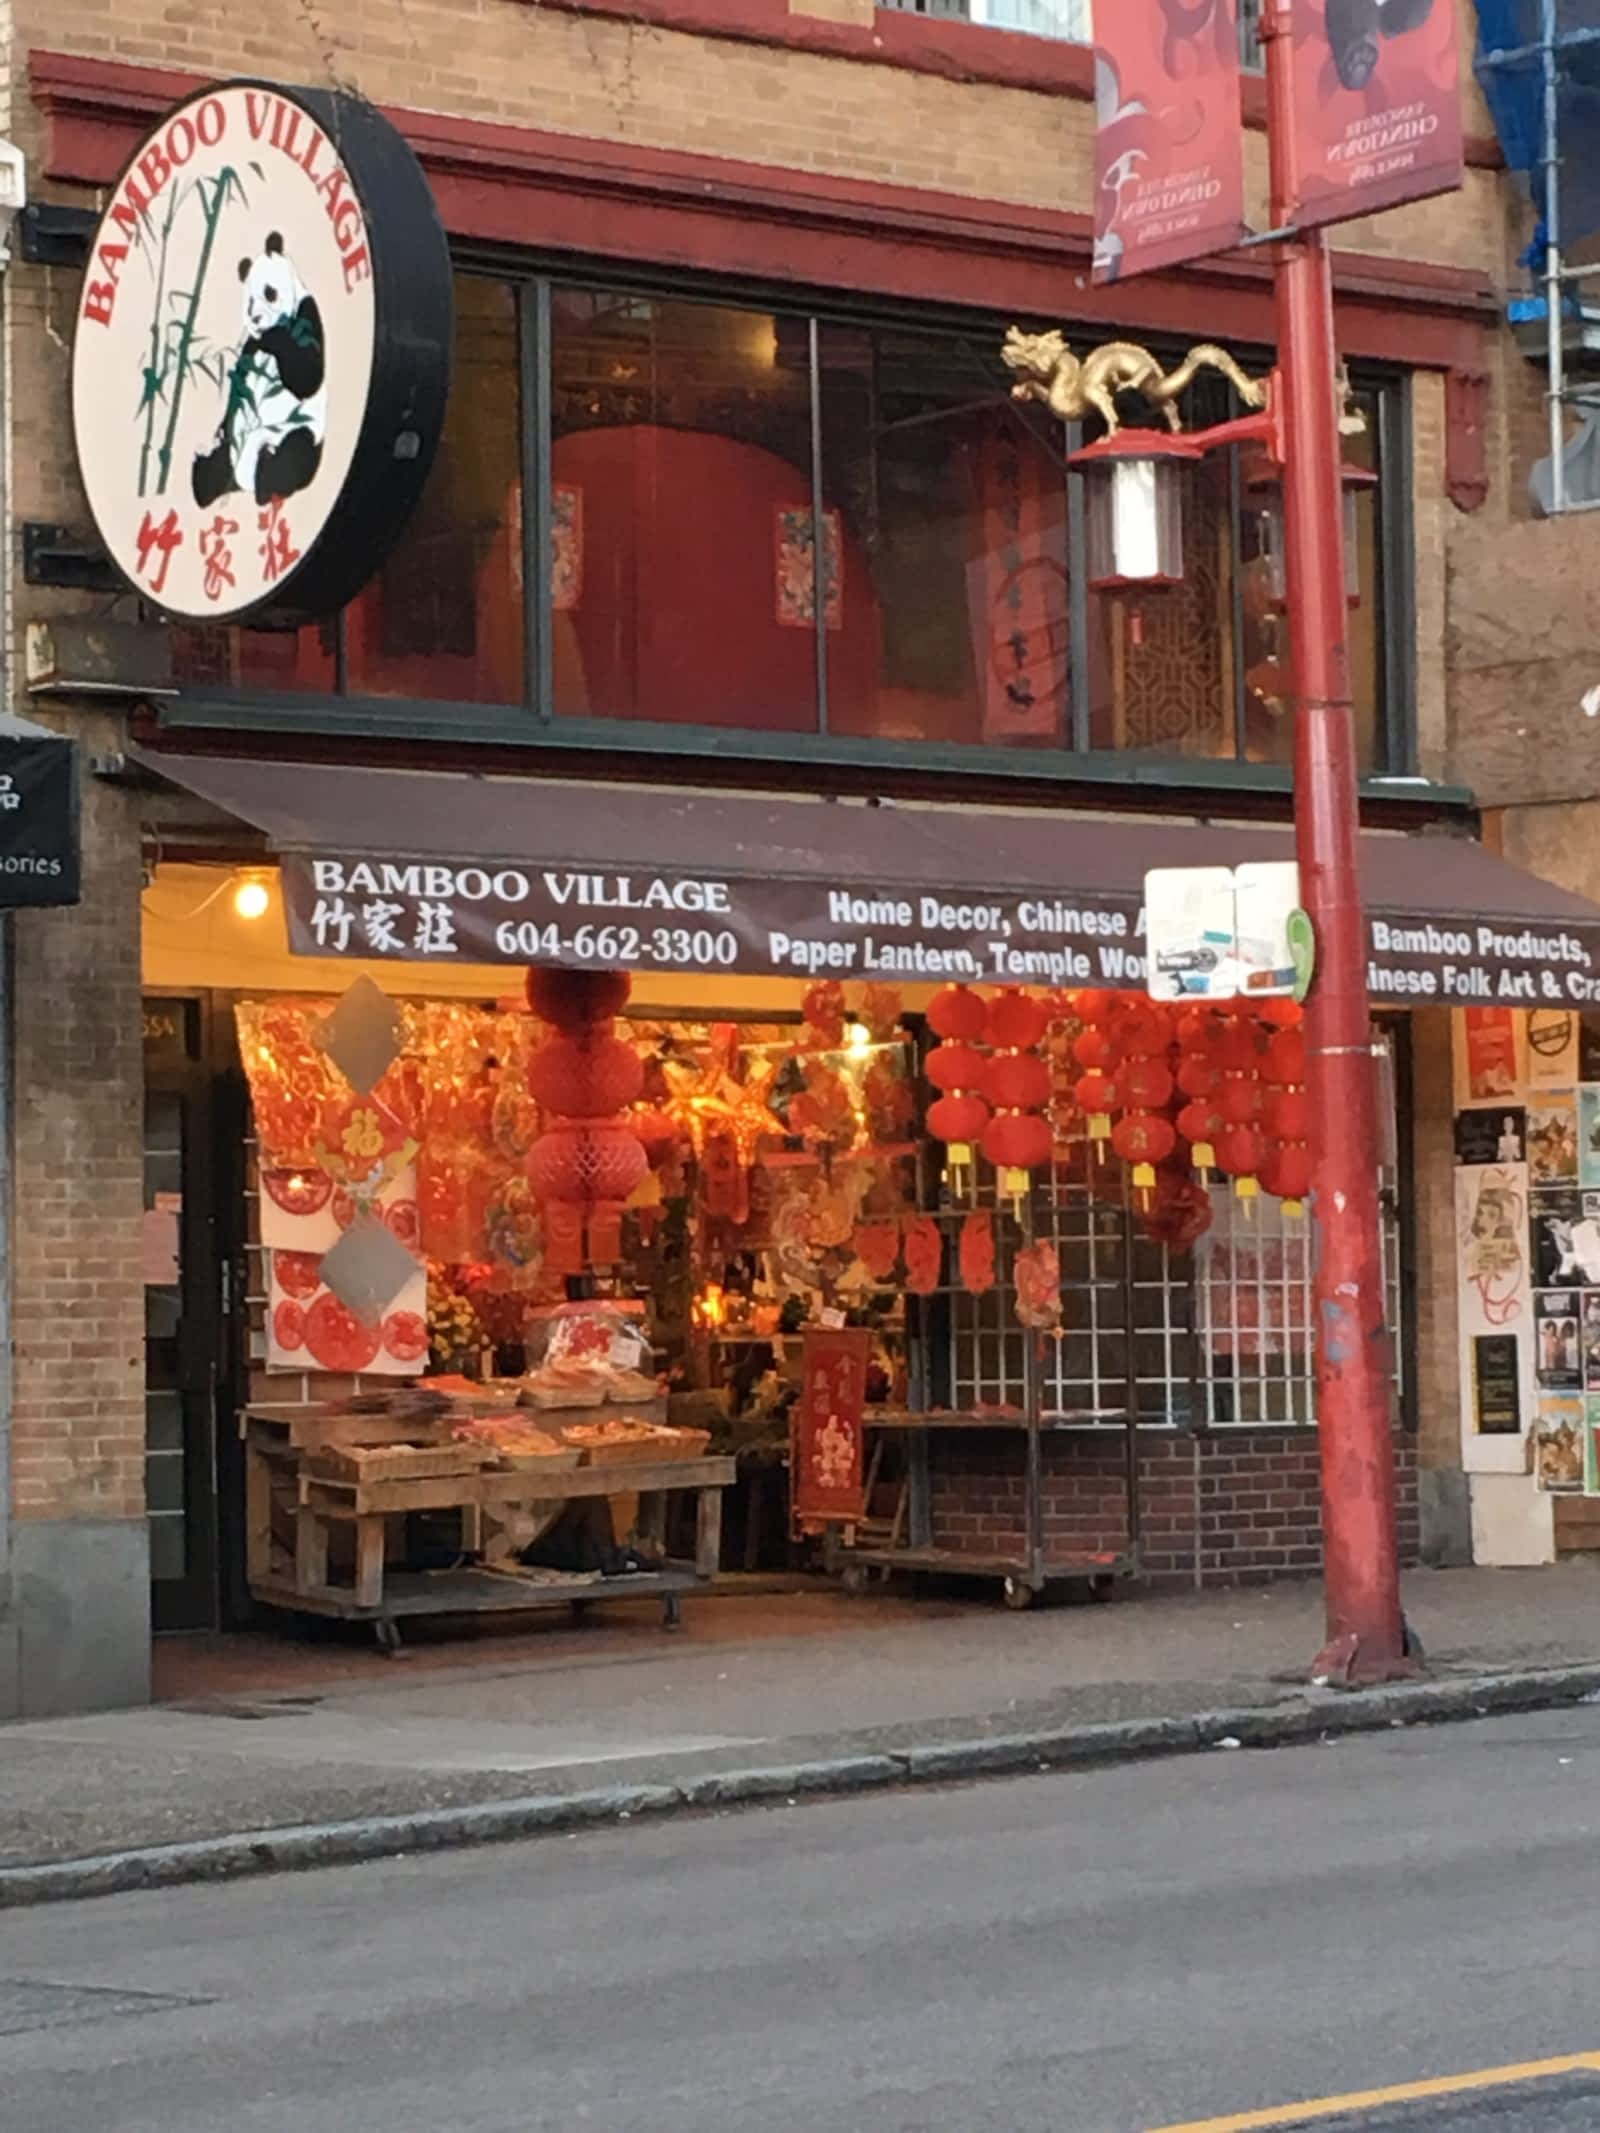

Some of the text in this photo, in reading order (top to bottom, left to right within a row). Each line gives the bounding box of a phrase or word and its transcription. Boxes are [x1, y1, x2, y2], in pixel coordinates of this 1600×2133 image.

[83, 91, 373, 329] BAMBOO VILLAGE
[312, 860, 732, 913] BAMBOO VILLAGE
[828, 891, 912, 927] Home
[920, 897, 1012, 936] Decor,
[1018, 901, 1127, 937] Chinese
[496, 920, 738, 965] 604-662-3300
[769, 932, 858, 973] Paper
[864, 937, 984, 979] Lantern,
[988, 942, 1090, 983] Temple
[1371, 921, 1592, 968] Bamboo Products,
[1366, 961, 1437, 994] inese
[1443, 965, 1492, 997] Folk
[1498, 969, 1537, 998] Art
[1541, 969, 1563, 998] &
